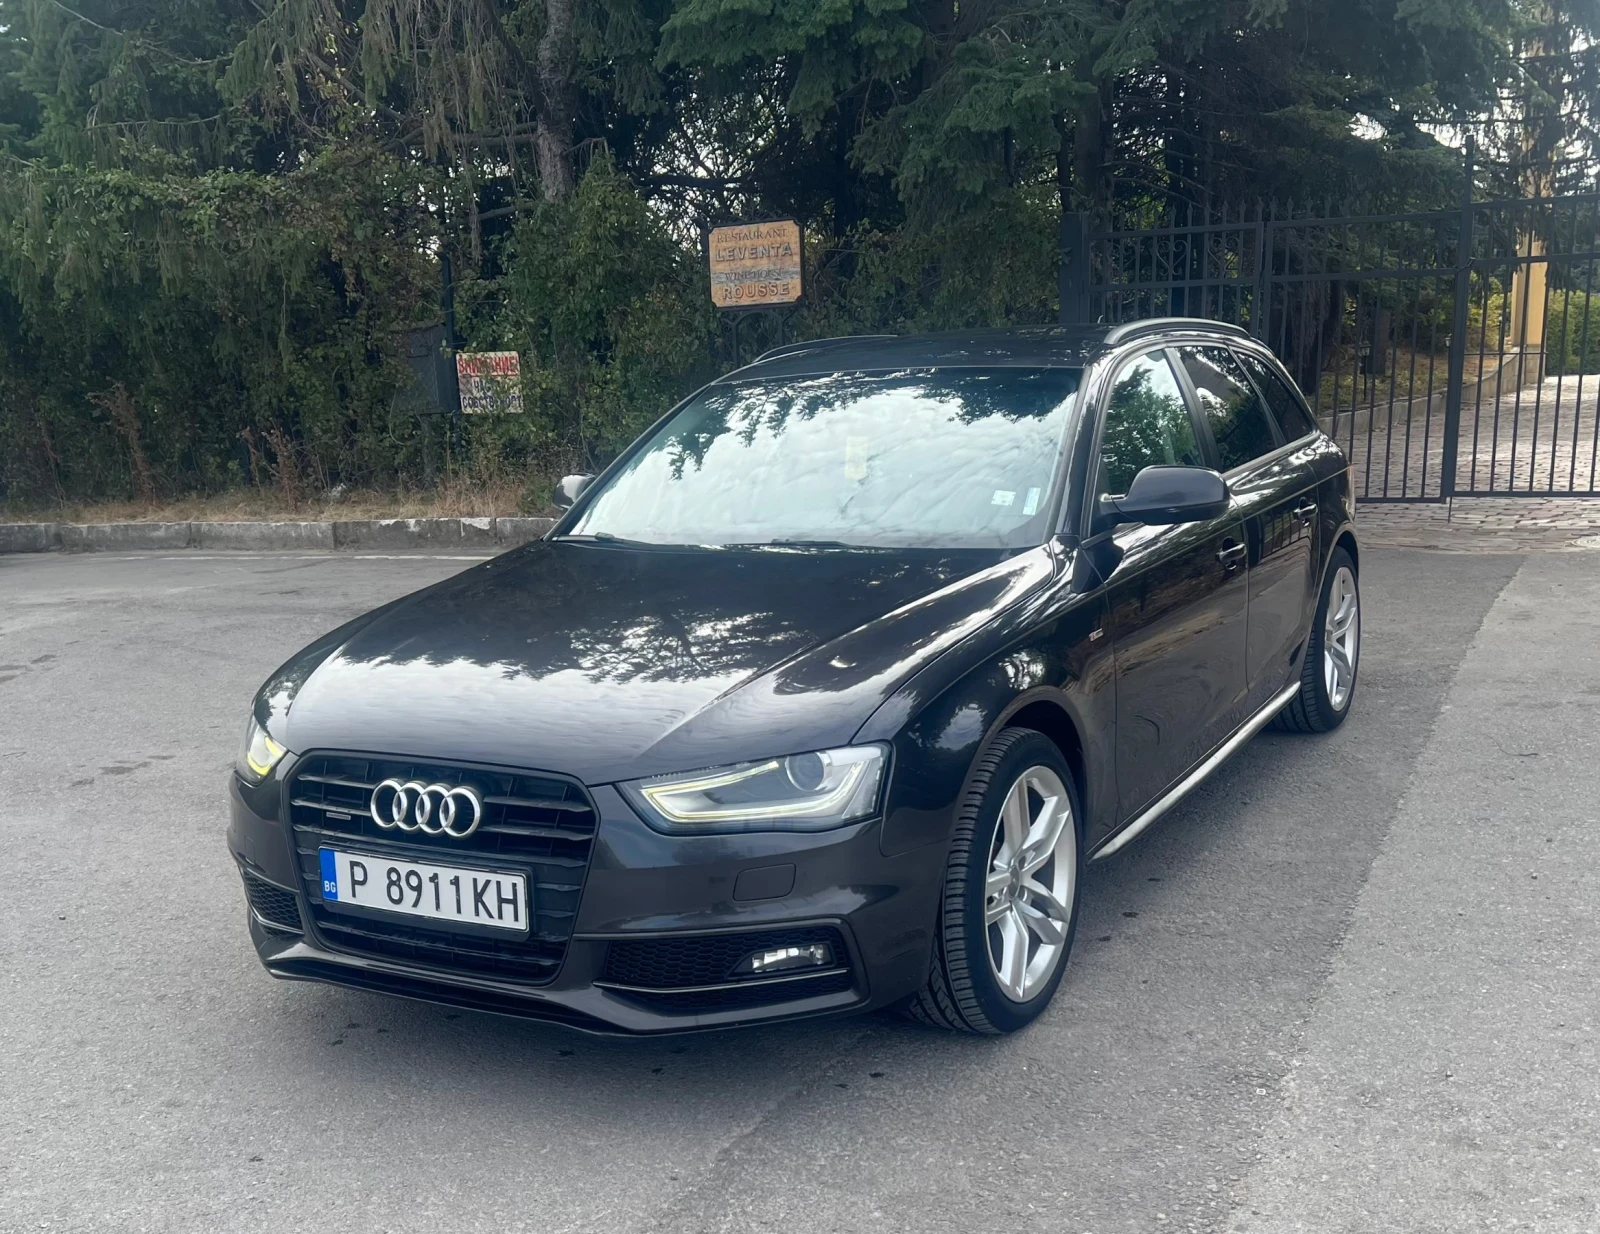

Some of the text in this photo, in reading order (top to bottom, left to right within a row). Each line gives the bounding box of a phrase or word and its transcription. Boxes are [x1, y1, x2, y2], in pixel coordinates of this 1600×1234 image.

[717, 228, 788, 243] RESTAURANT
[716, 242, 793, 262] LEVENTA
[723, 281, 790, 300] ROUSSE
[324, 880, 337, 894] BG
[349, 859, 368, 899] P
